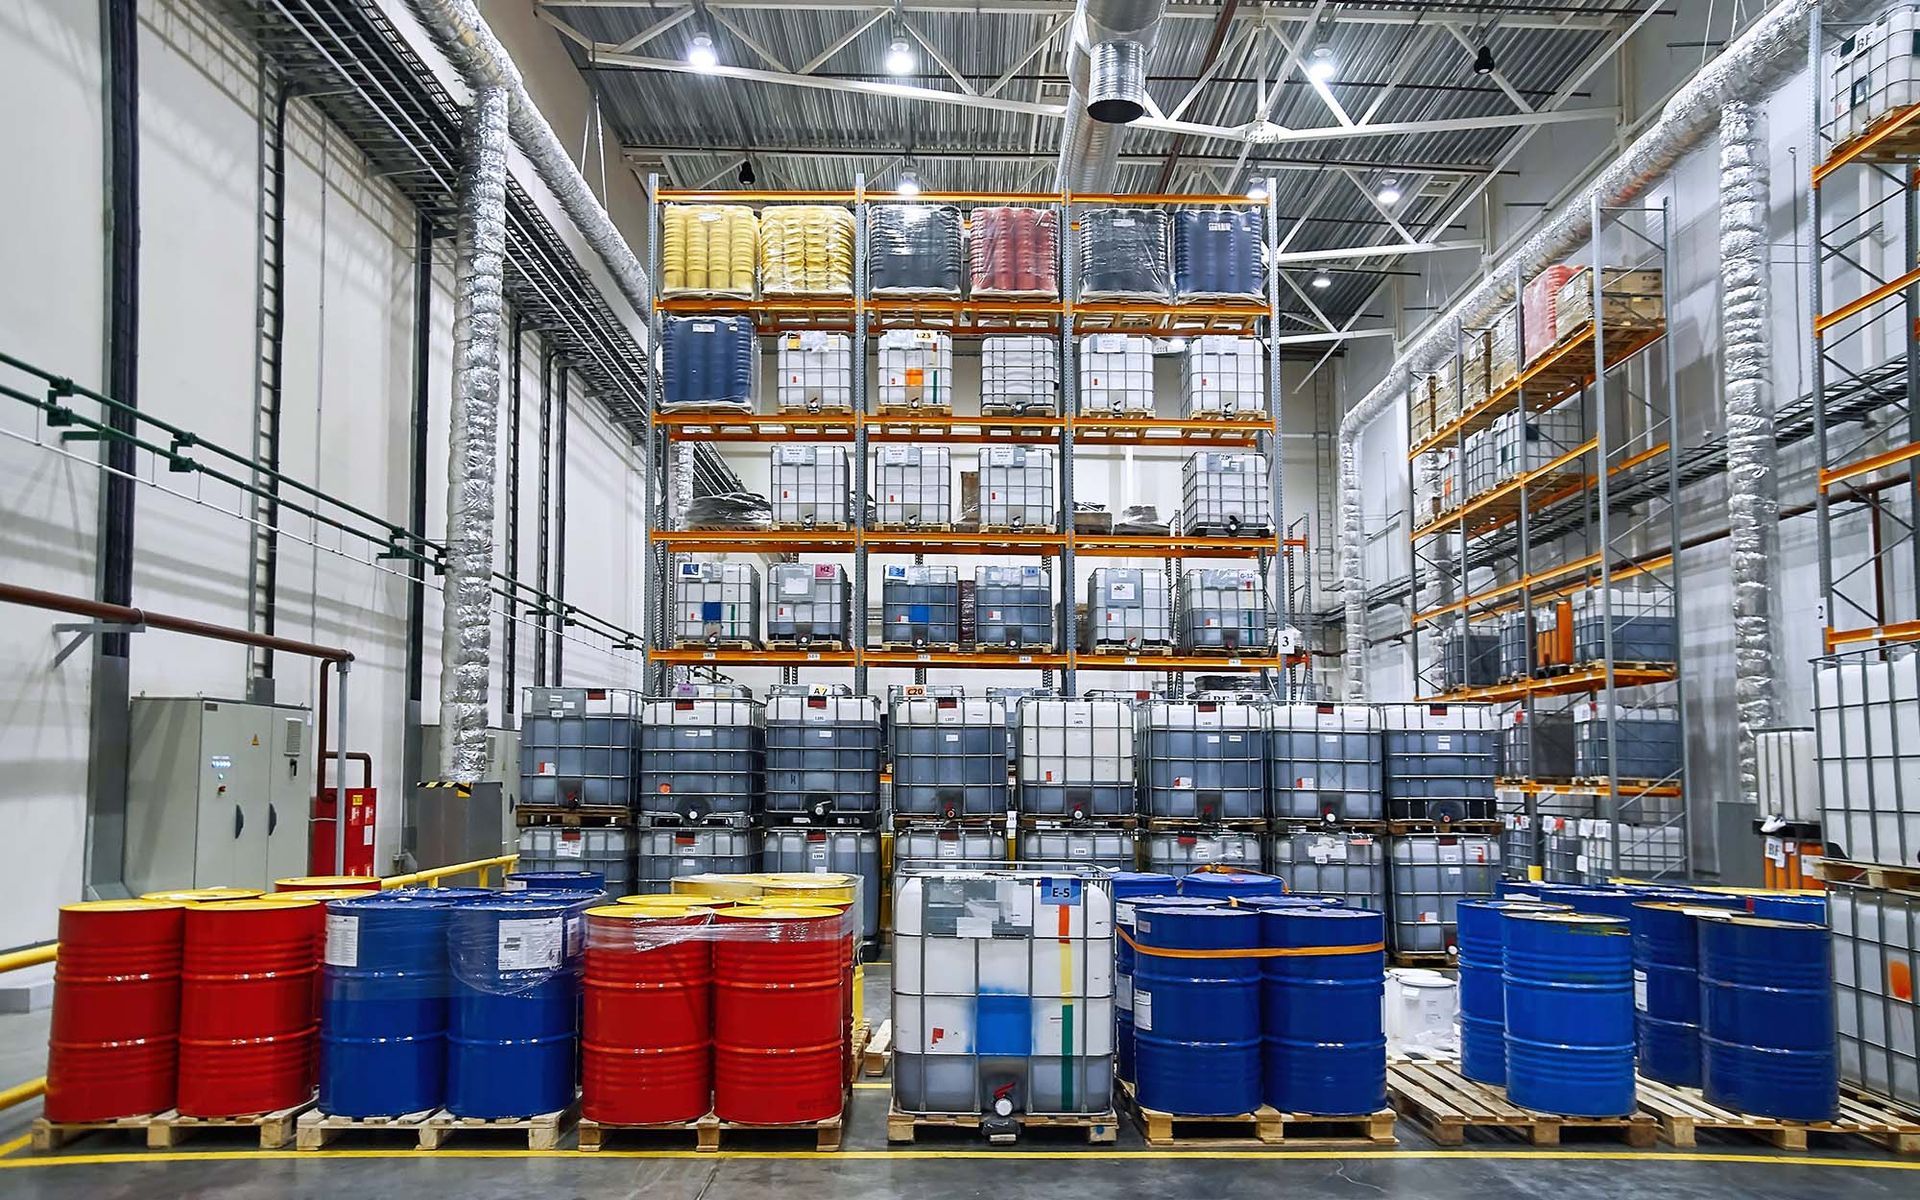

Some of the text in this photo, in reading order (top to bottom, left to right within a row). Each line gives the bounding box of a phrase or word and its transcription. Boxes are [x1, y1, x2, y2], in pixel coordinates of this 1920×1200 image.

[1282, 636, 1289, 647] 3
[907, 688, 923, 696] C20
[1052, 887, 1070, 898] E-5
